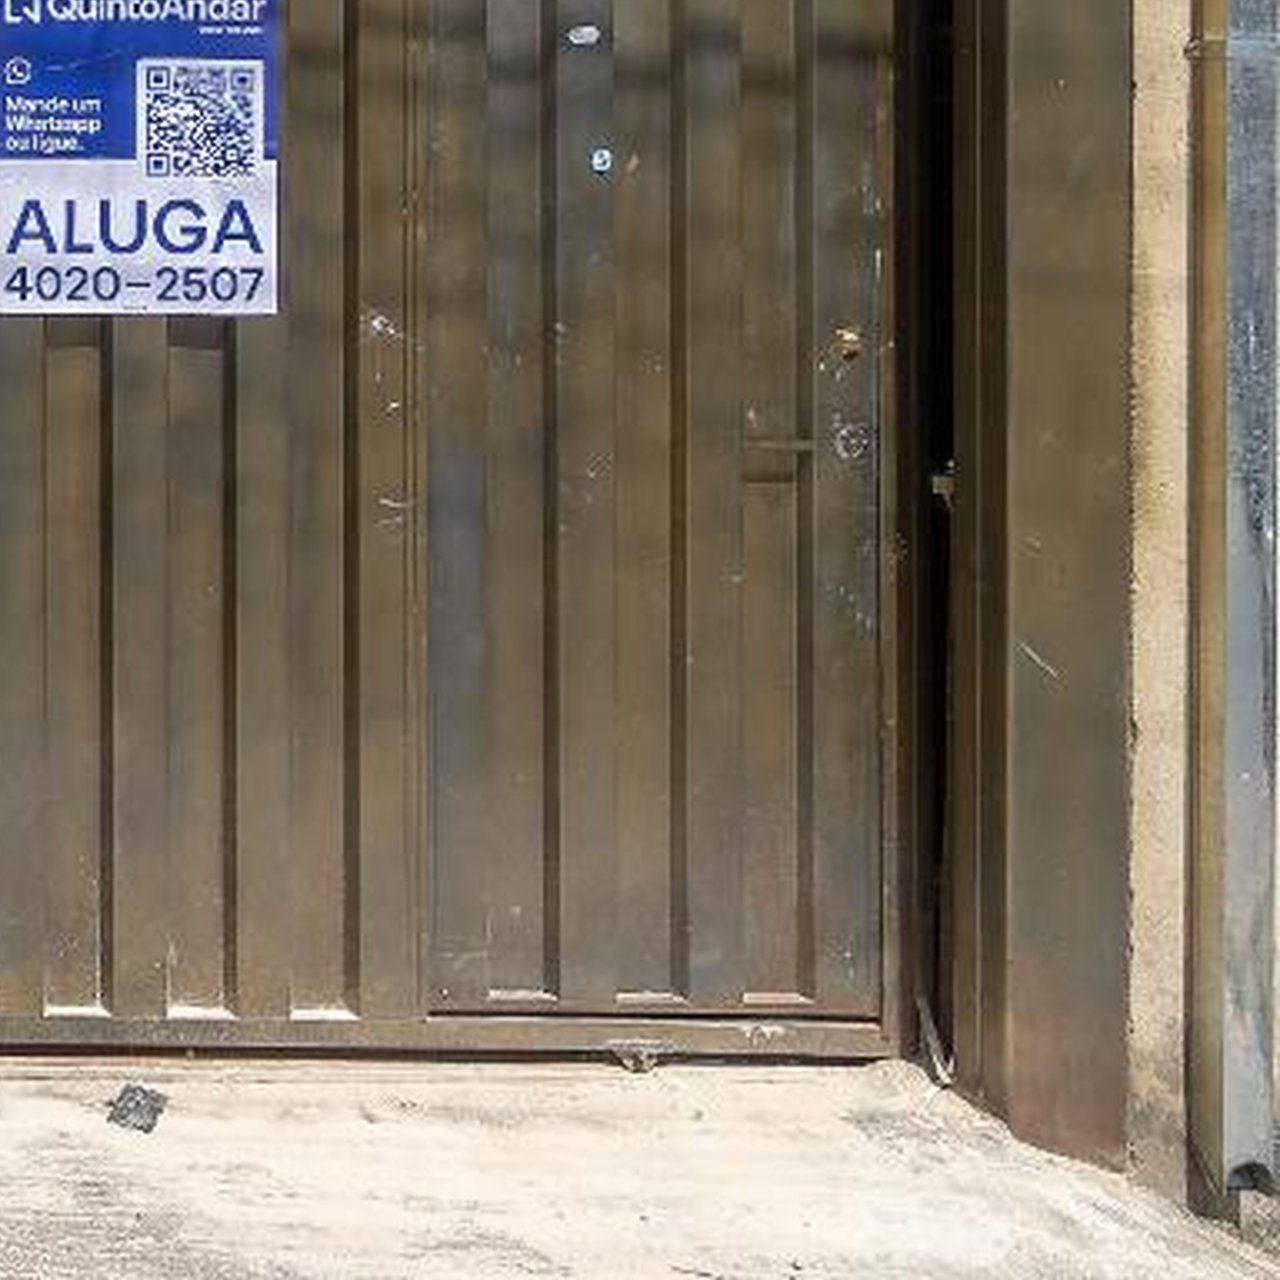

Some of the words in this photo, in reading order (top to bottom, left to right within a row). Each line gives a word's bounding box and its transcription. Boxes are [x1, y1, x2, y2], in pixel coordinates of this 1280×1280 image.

[5, 96, 71, 114] Mande
[72, 99, 101, 114] um
[6, 199, 264, 254] ALUGA
[4, 266, 264, 301] 4020-2507
